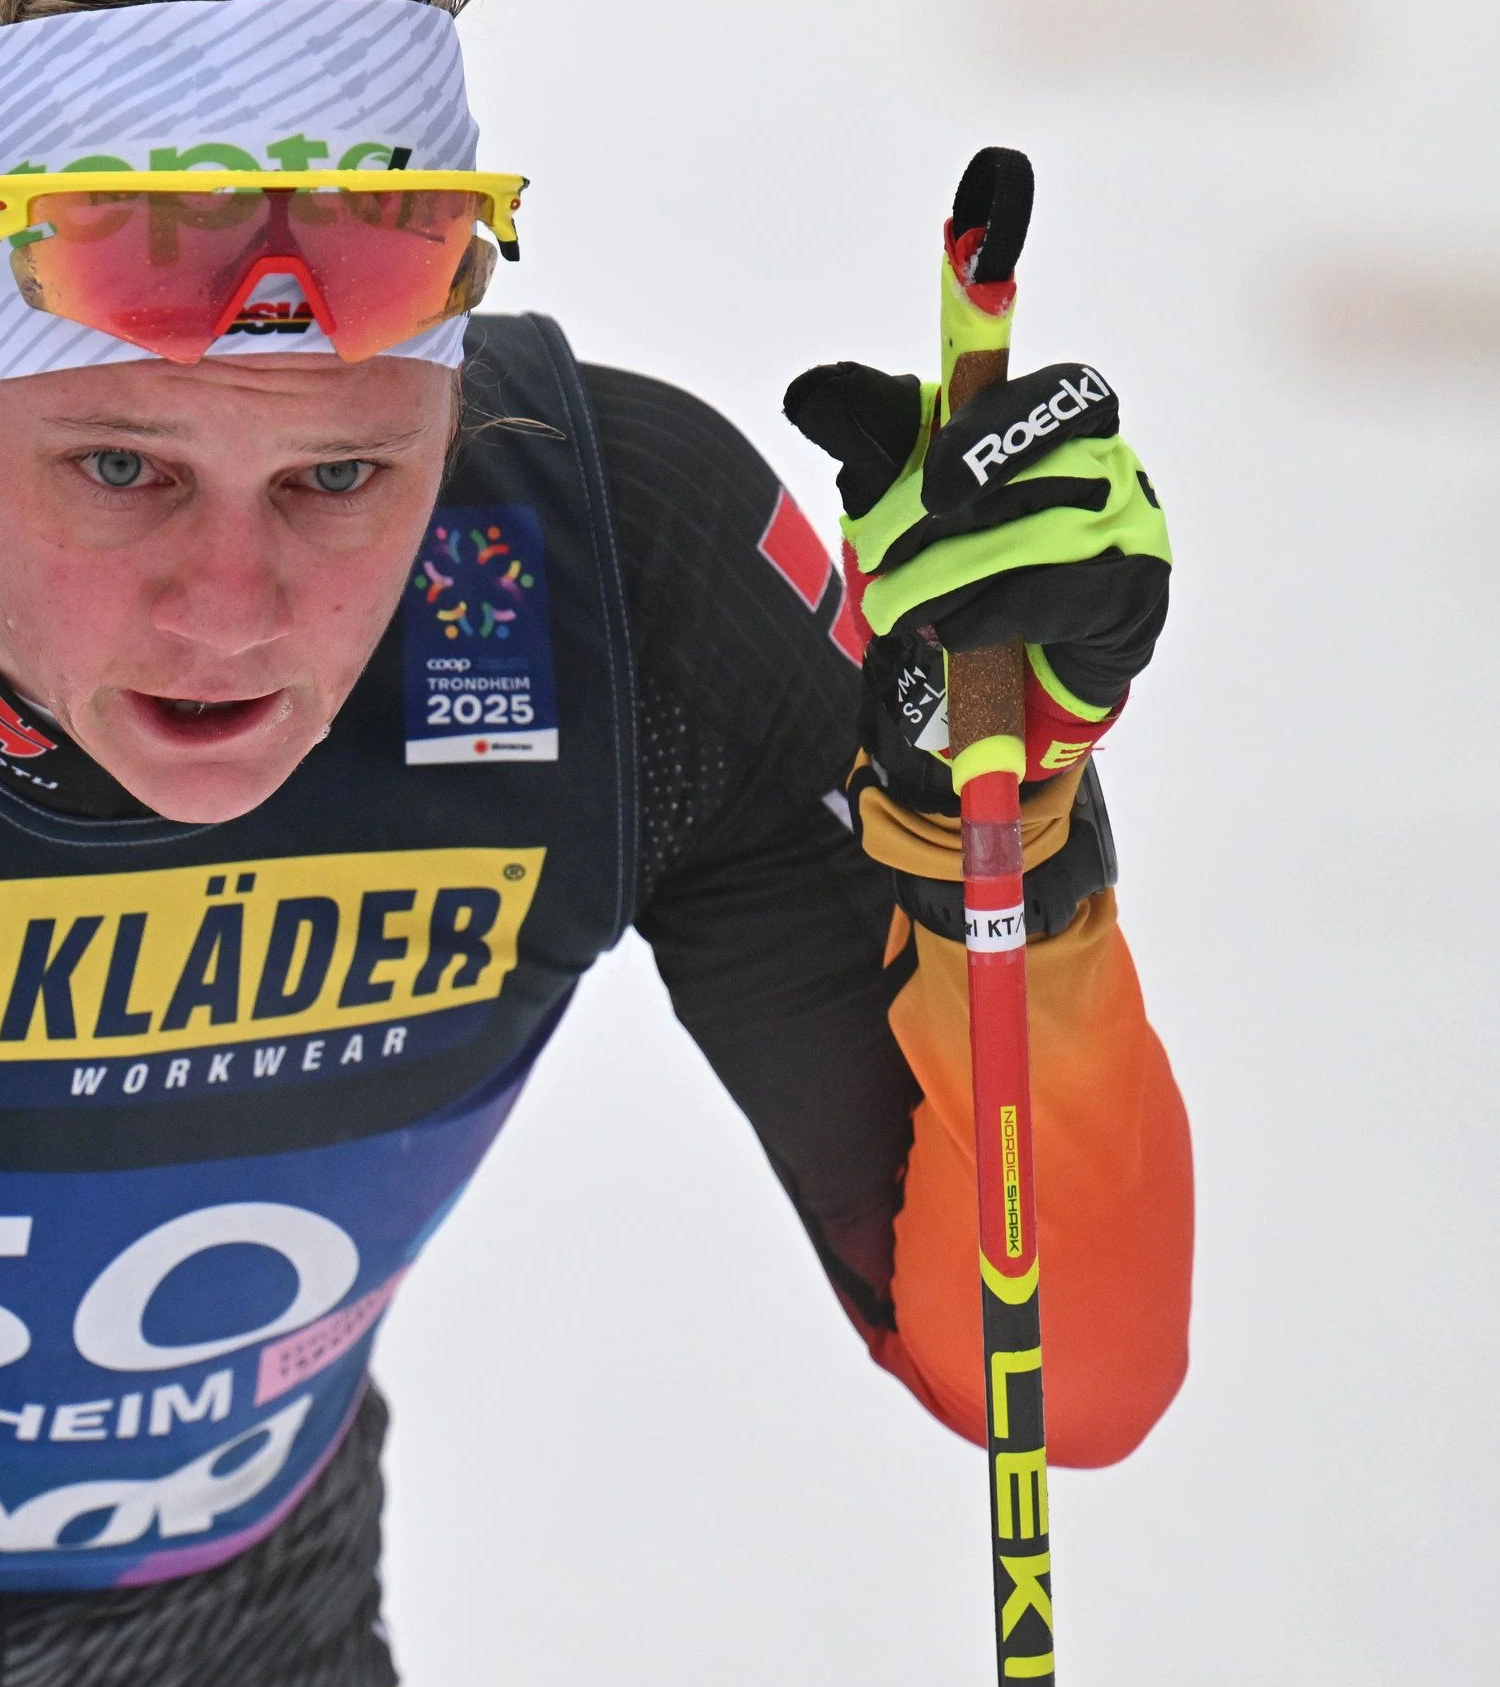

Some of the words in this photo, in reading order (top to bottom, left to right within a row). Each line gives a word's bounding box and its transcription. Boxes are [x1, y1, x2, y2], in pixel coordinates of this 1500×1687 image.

[426, 657, 472, 673] coop
[427, 676, 531, 691] TRONDHEIM
[426, 693, 535, 725] 2025
[70, 1026, 408, 1097] WORKWEAR
[1004, 1110, 1017, 1182] NORDIC
[1007, 1185, 1020, 1252] SHARK
